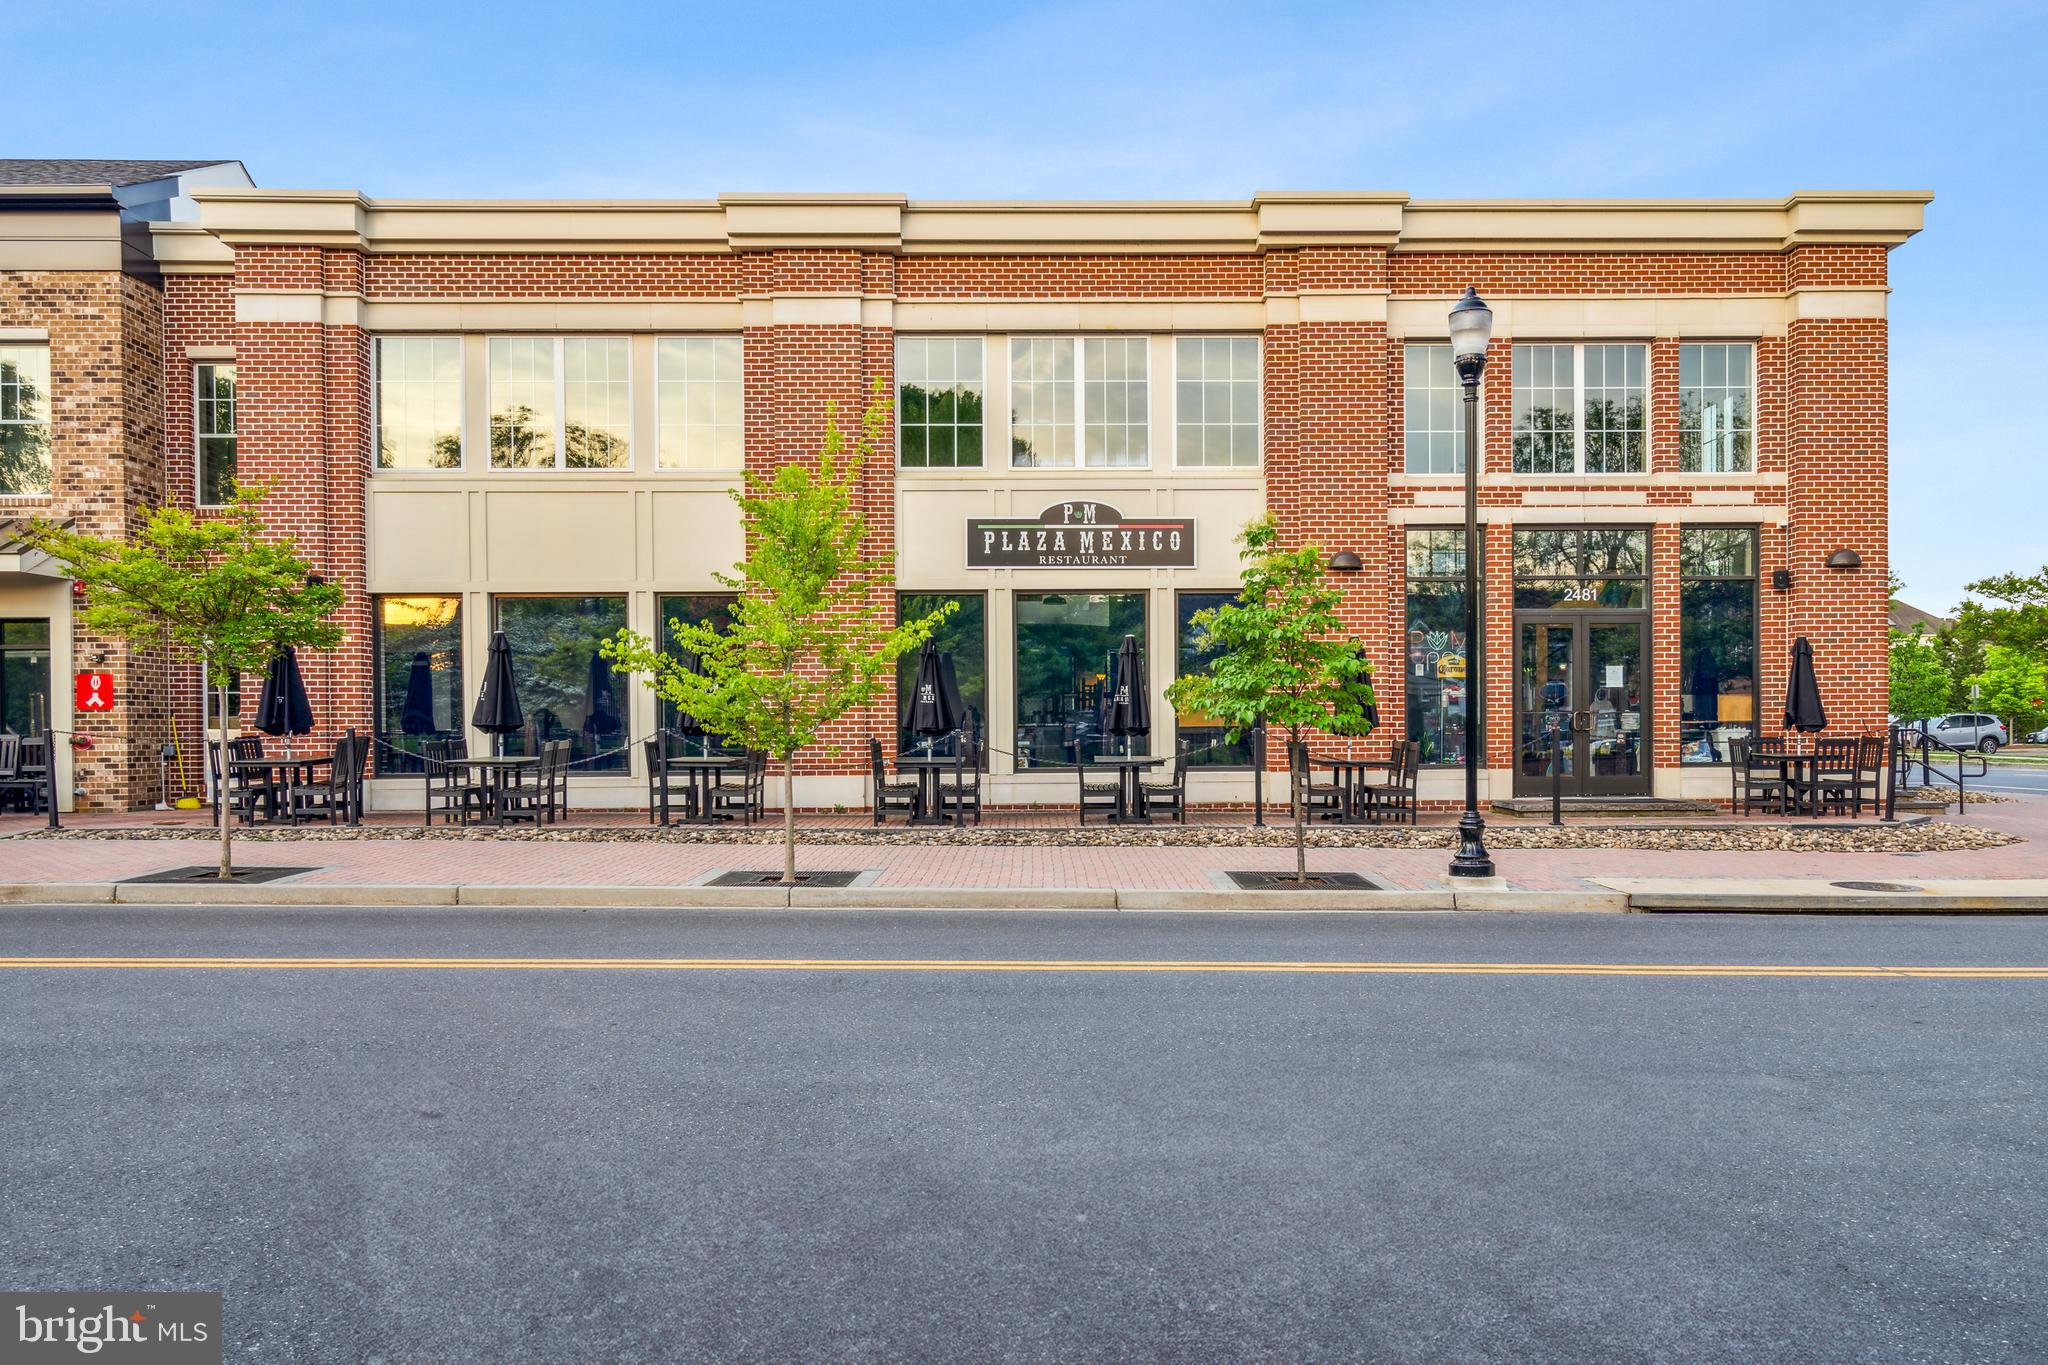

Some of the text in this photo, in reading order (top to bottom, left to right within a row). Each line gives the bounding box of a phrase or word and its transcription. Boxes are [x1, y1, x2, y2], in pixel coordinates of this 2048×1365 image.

[984, 531, 1181, 554] PLAZA MEXICO
[1039, 555, 1128, 565] RESTAURANT
[1563, 588, 1597, 602] 2481
